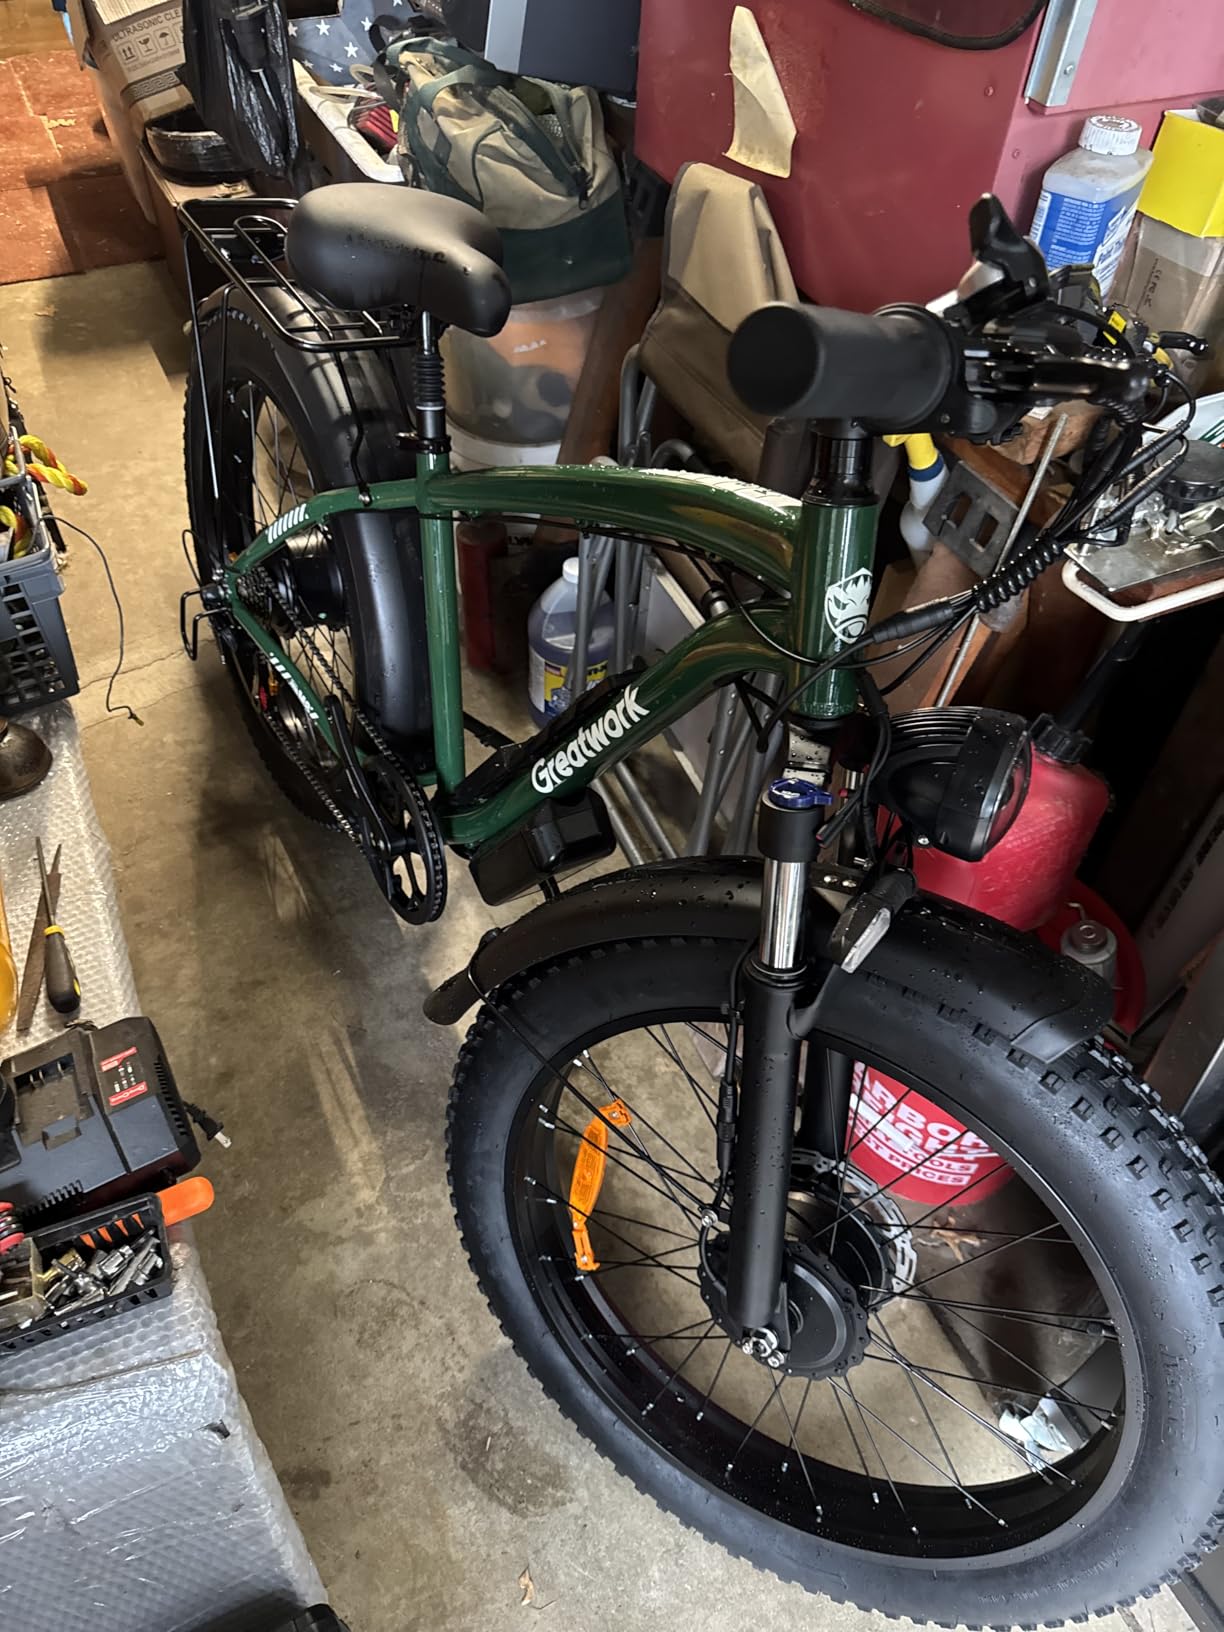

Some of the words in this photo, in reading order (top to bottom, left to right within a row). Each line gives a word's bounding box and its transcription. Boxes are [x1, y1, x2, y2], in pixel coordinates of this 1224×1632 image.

[112, 15, 163, 42] ULTRASONIC
[164, 8, 182, 22] CLE
[531, 684, 650, 794] Greatwork
[888, 1153, 964, 1183] PRICES
